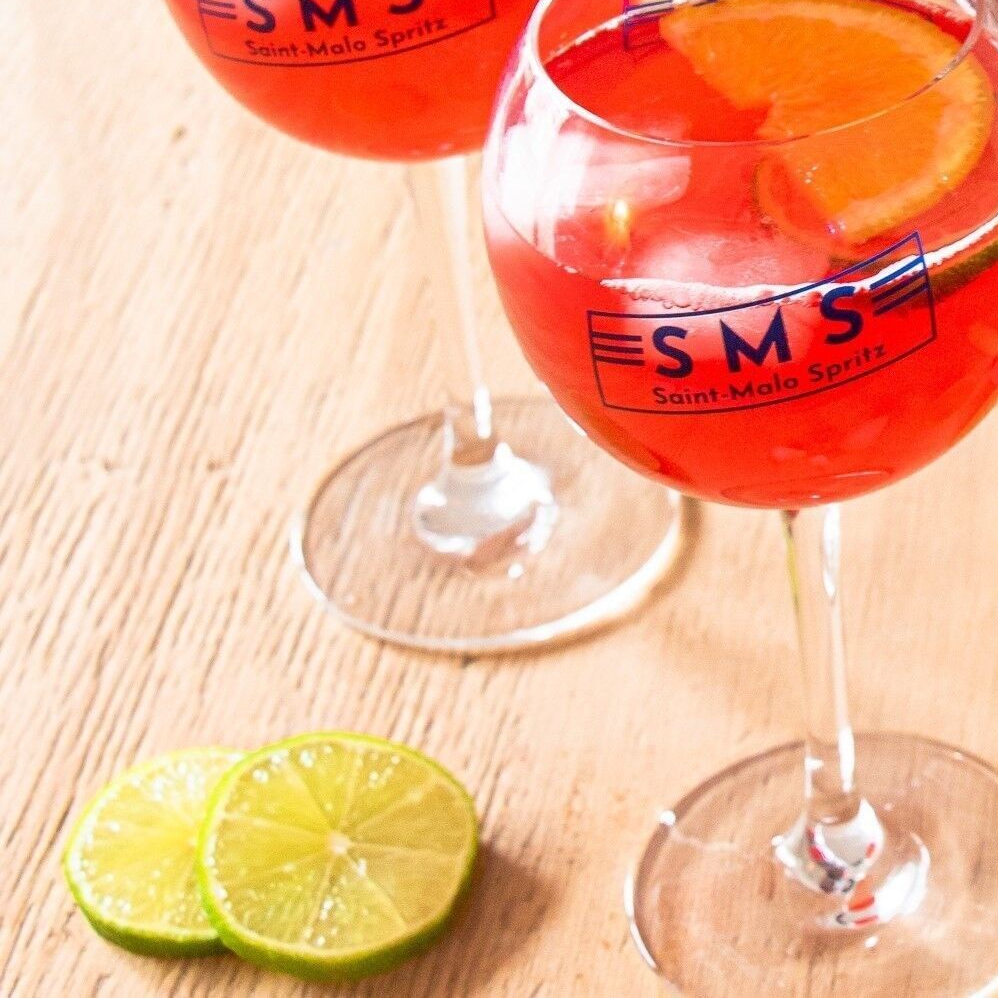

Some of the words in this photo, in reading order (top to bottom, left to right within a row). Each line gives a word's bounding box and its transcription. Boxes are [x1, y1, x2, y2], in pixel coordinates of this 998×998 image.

[244, 35, 367, 58] Saint-Malo
[374, 17, 448, 49] Spritz
[652, 372, 799, 406] Saint-Malo
[808, 343, 887, 383] Spritz
